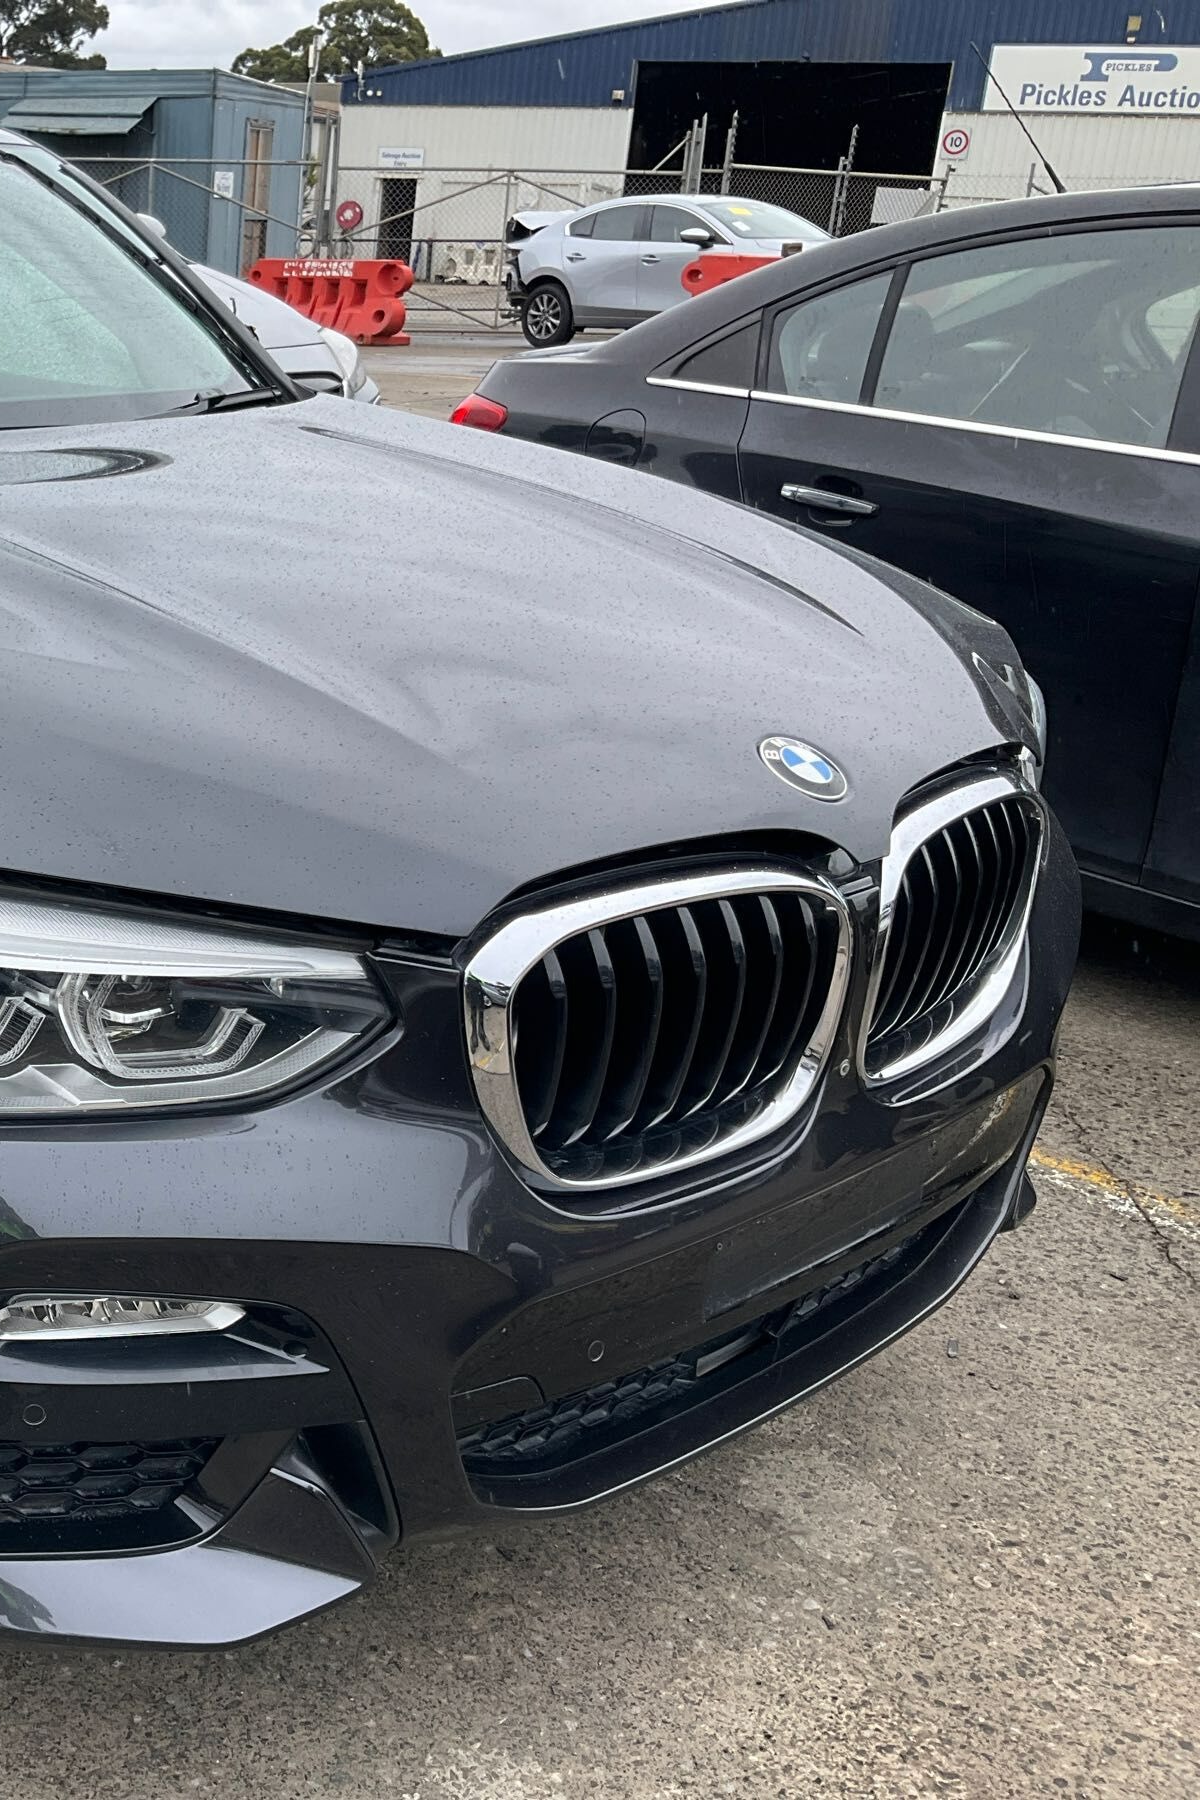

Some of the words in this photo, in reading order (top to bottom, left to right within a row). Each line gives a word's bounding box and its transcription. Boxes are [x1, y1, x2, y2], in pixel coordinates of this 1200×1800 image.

[1105, 62, 1153, 72] PICKLES
[1019, 83, 1107, 106] Pickles
[1117, 84, 1200, 108] Auctio
[950, 136, 963, 148] 10
